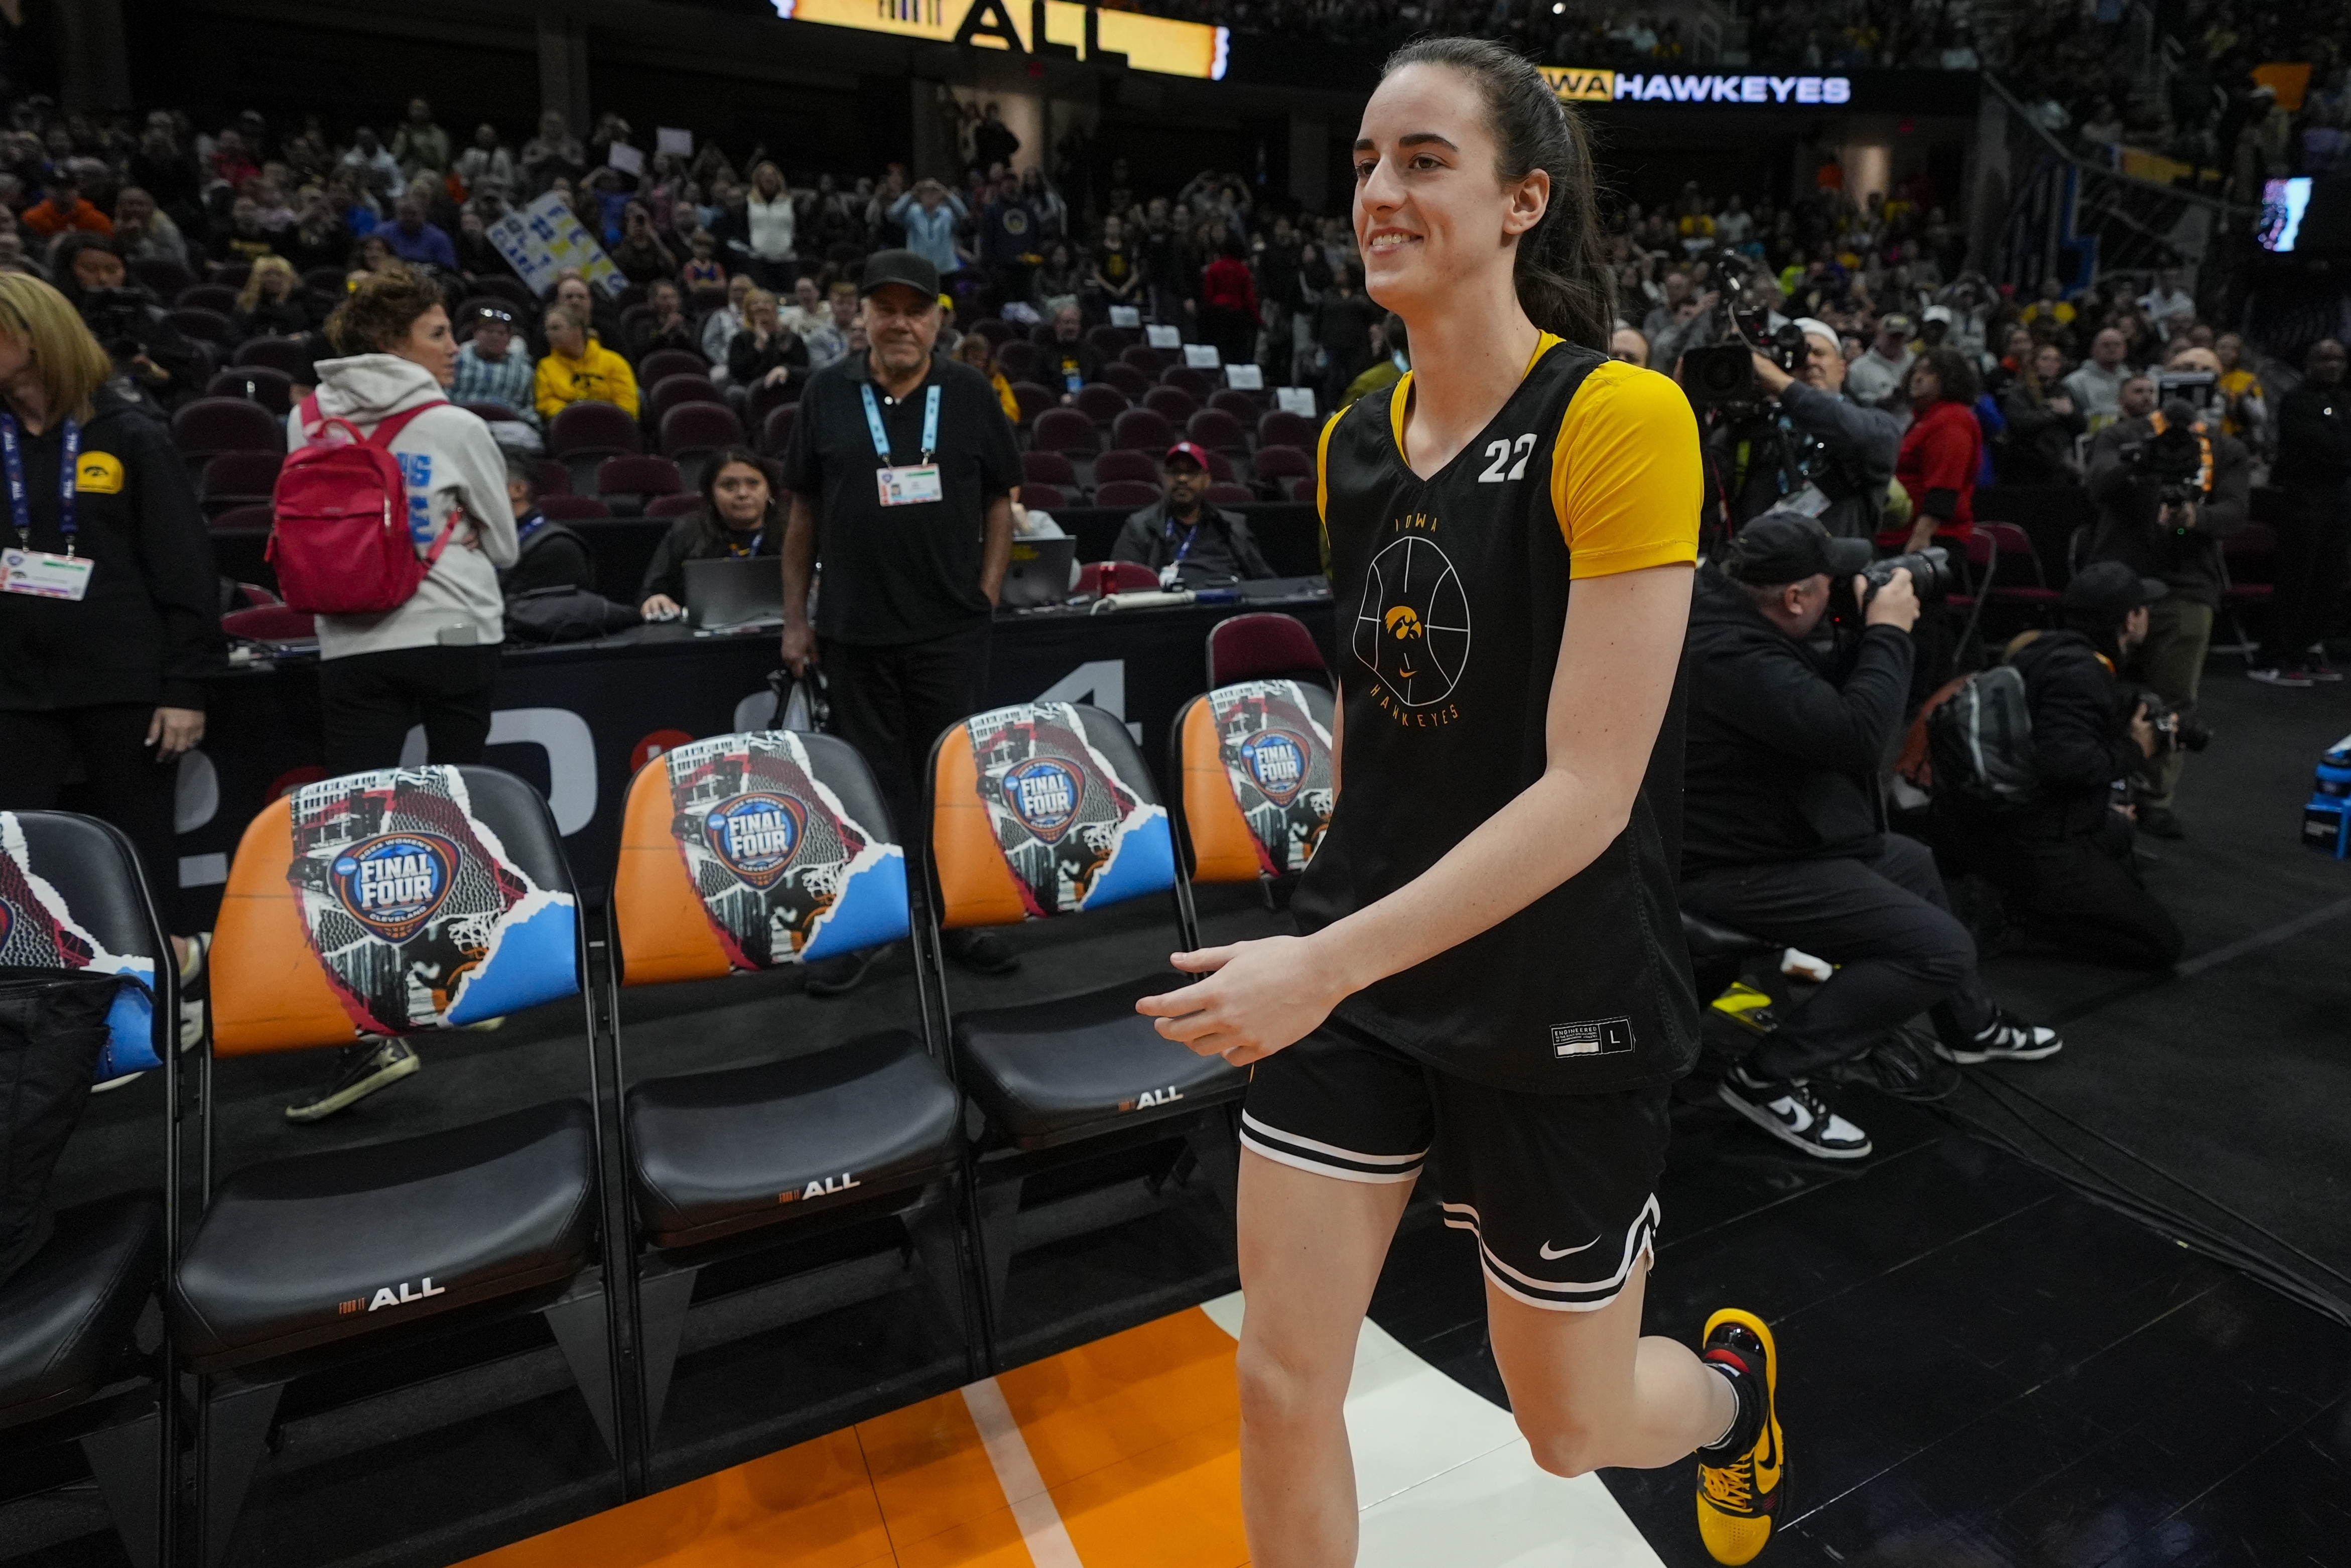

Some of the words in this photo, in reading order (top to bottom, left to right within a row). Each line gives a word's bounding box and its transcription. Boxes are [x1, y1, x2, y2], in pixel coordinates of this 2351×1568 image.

[953, 0, 1128, 67] ALL
[1548, 73, 1607, 93] WA
[1614, 73, 1851, 103] HAWKEYES
[1478, 433, 1537, 483] 22
[1395, 513, 1436, 532] IOWA
[1370, 684, 1458, 726] HAWKEYES
[1255, 744, 1296, 764] FINAL
[1259, 761, 1300, 783] FOUR
[1019, 774, 1068, 797] FINAL
[1023, 792, 1071, 817] FOUR
[728, 810, 786, 836] FINAL
[730, 830, 789, 859] FOUR
[360, 853, 432, 883] FINAL
[361, 875, 434, 909] FOUR
[369, 905, 427, 923] CLEVELAND
[1555, 1026, 1597, 1036] ENGINEERED
[1610, 1030, 1621, 1044] L
[1136, 1085, 1184, 1110] ALL
[802, 1172, 861, 1200] ALL
[368, 1277, 445, 1312] ALL
